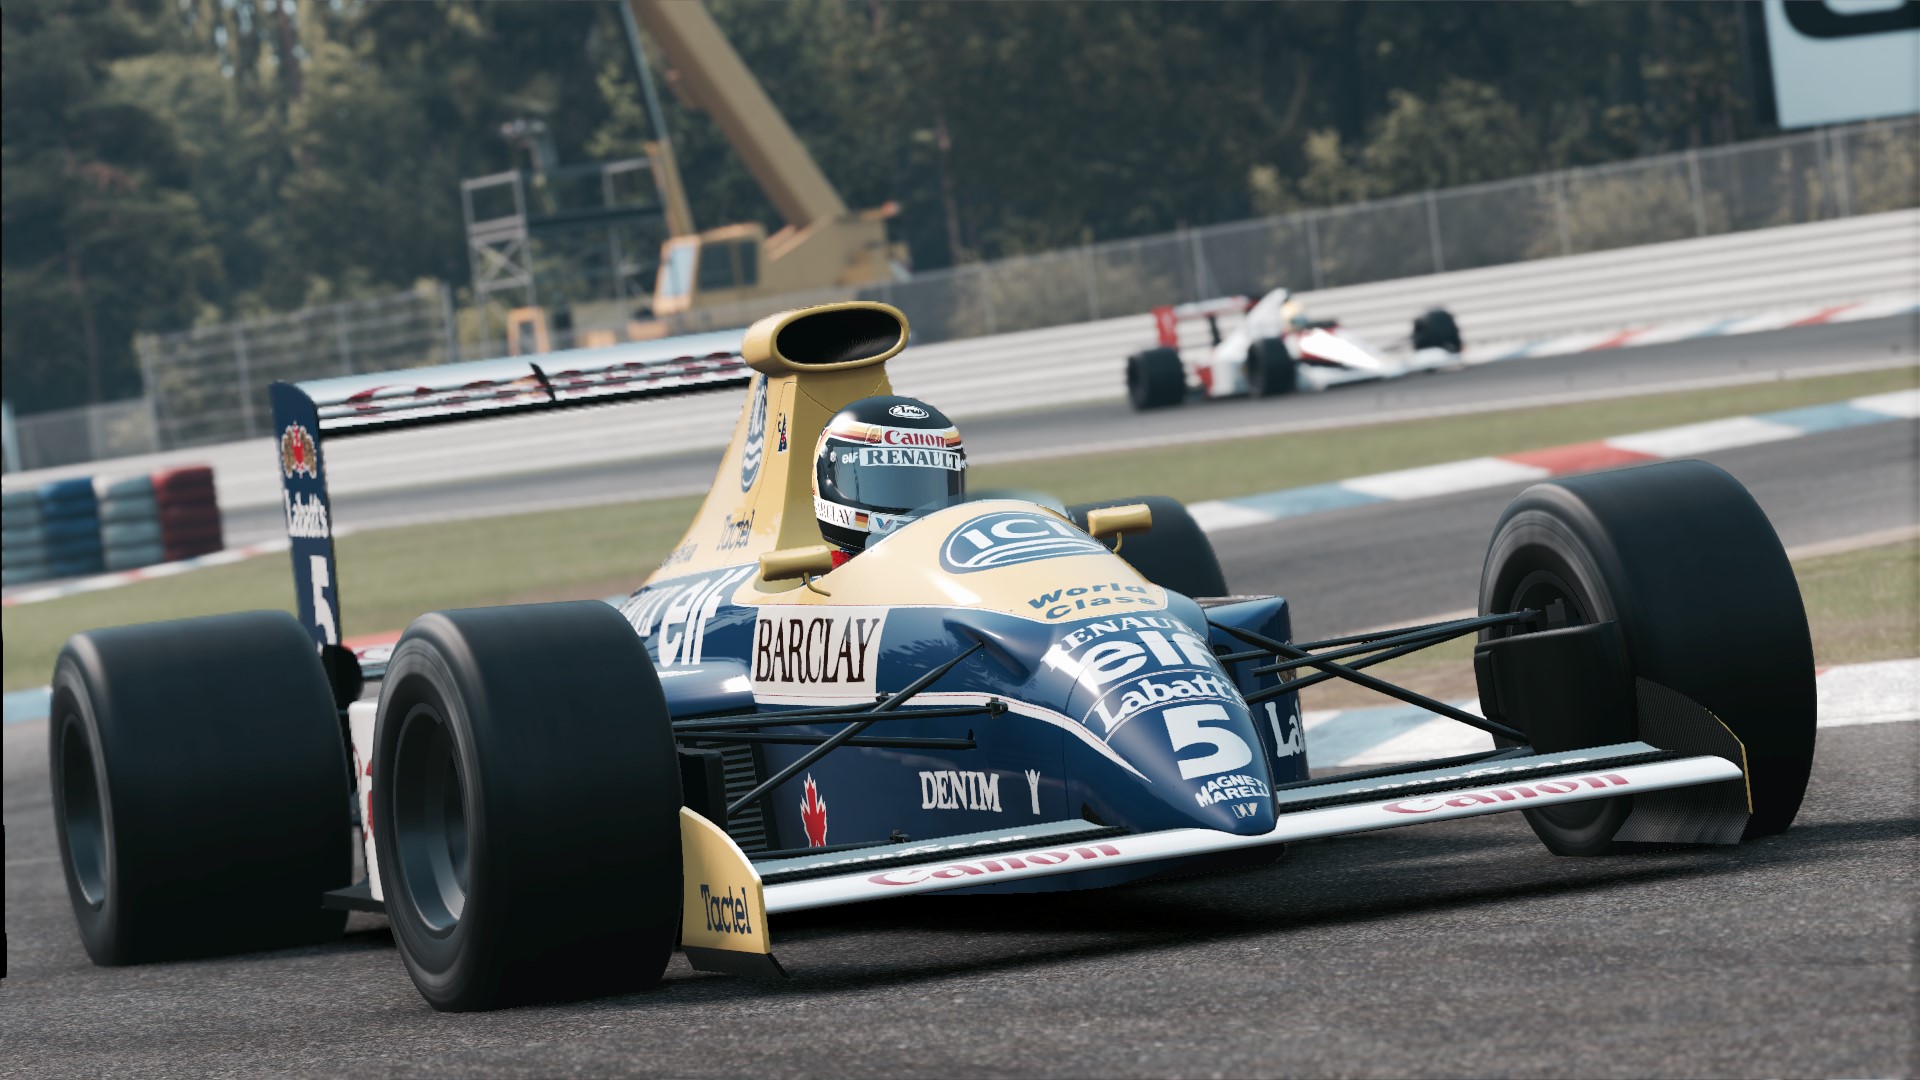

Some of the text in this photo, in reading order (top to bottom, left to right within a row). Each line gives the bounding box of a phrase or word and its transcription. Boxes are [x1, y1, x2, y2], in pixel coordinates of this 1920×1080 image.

[841, 452, 859, 464] elf
[884, 429, 946, 448] Canon
[867, 450, 958, 470] RENAULT
[960, 518, 1076, 550] ICI
[309, 555, 337, 657] 5
[658, 565, 754, 668] elf
[1028, 582, 1147, 610] World
[1046, 596, 1158, 619] Class
[755, 616, 881, 684] BARCLAY
[1162, 703, 1252, 780] 5
[918, 770, 1003, 813] DENIM
[1382, 774, 1630, 815] Canon
[868, 842, 1122, 886] Canon
[700, 884, 752, 935] Tactel
